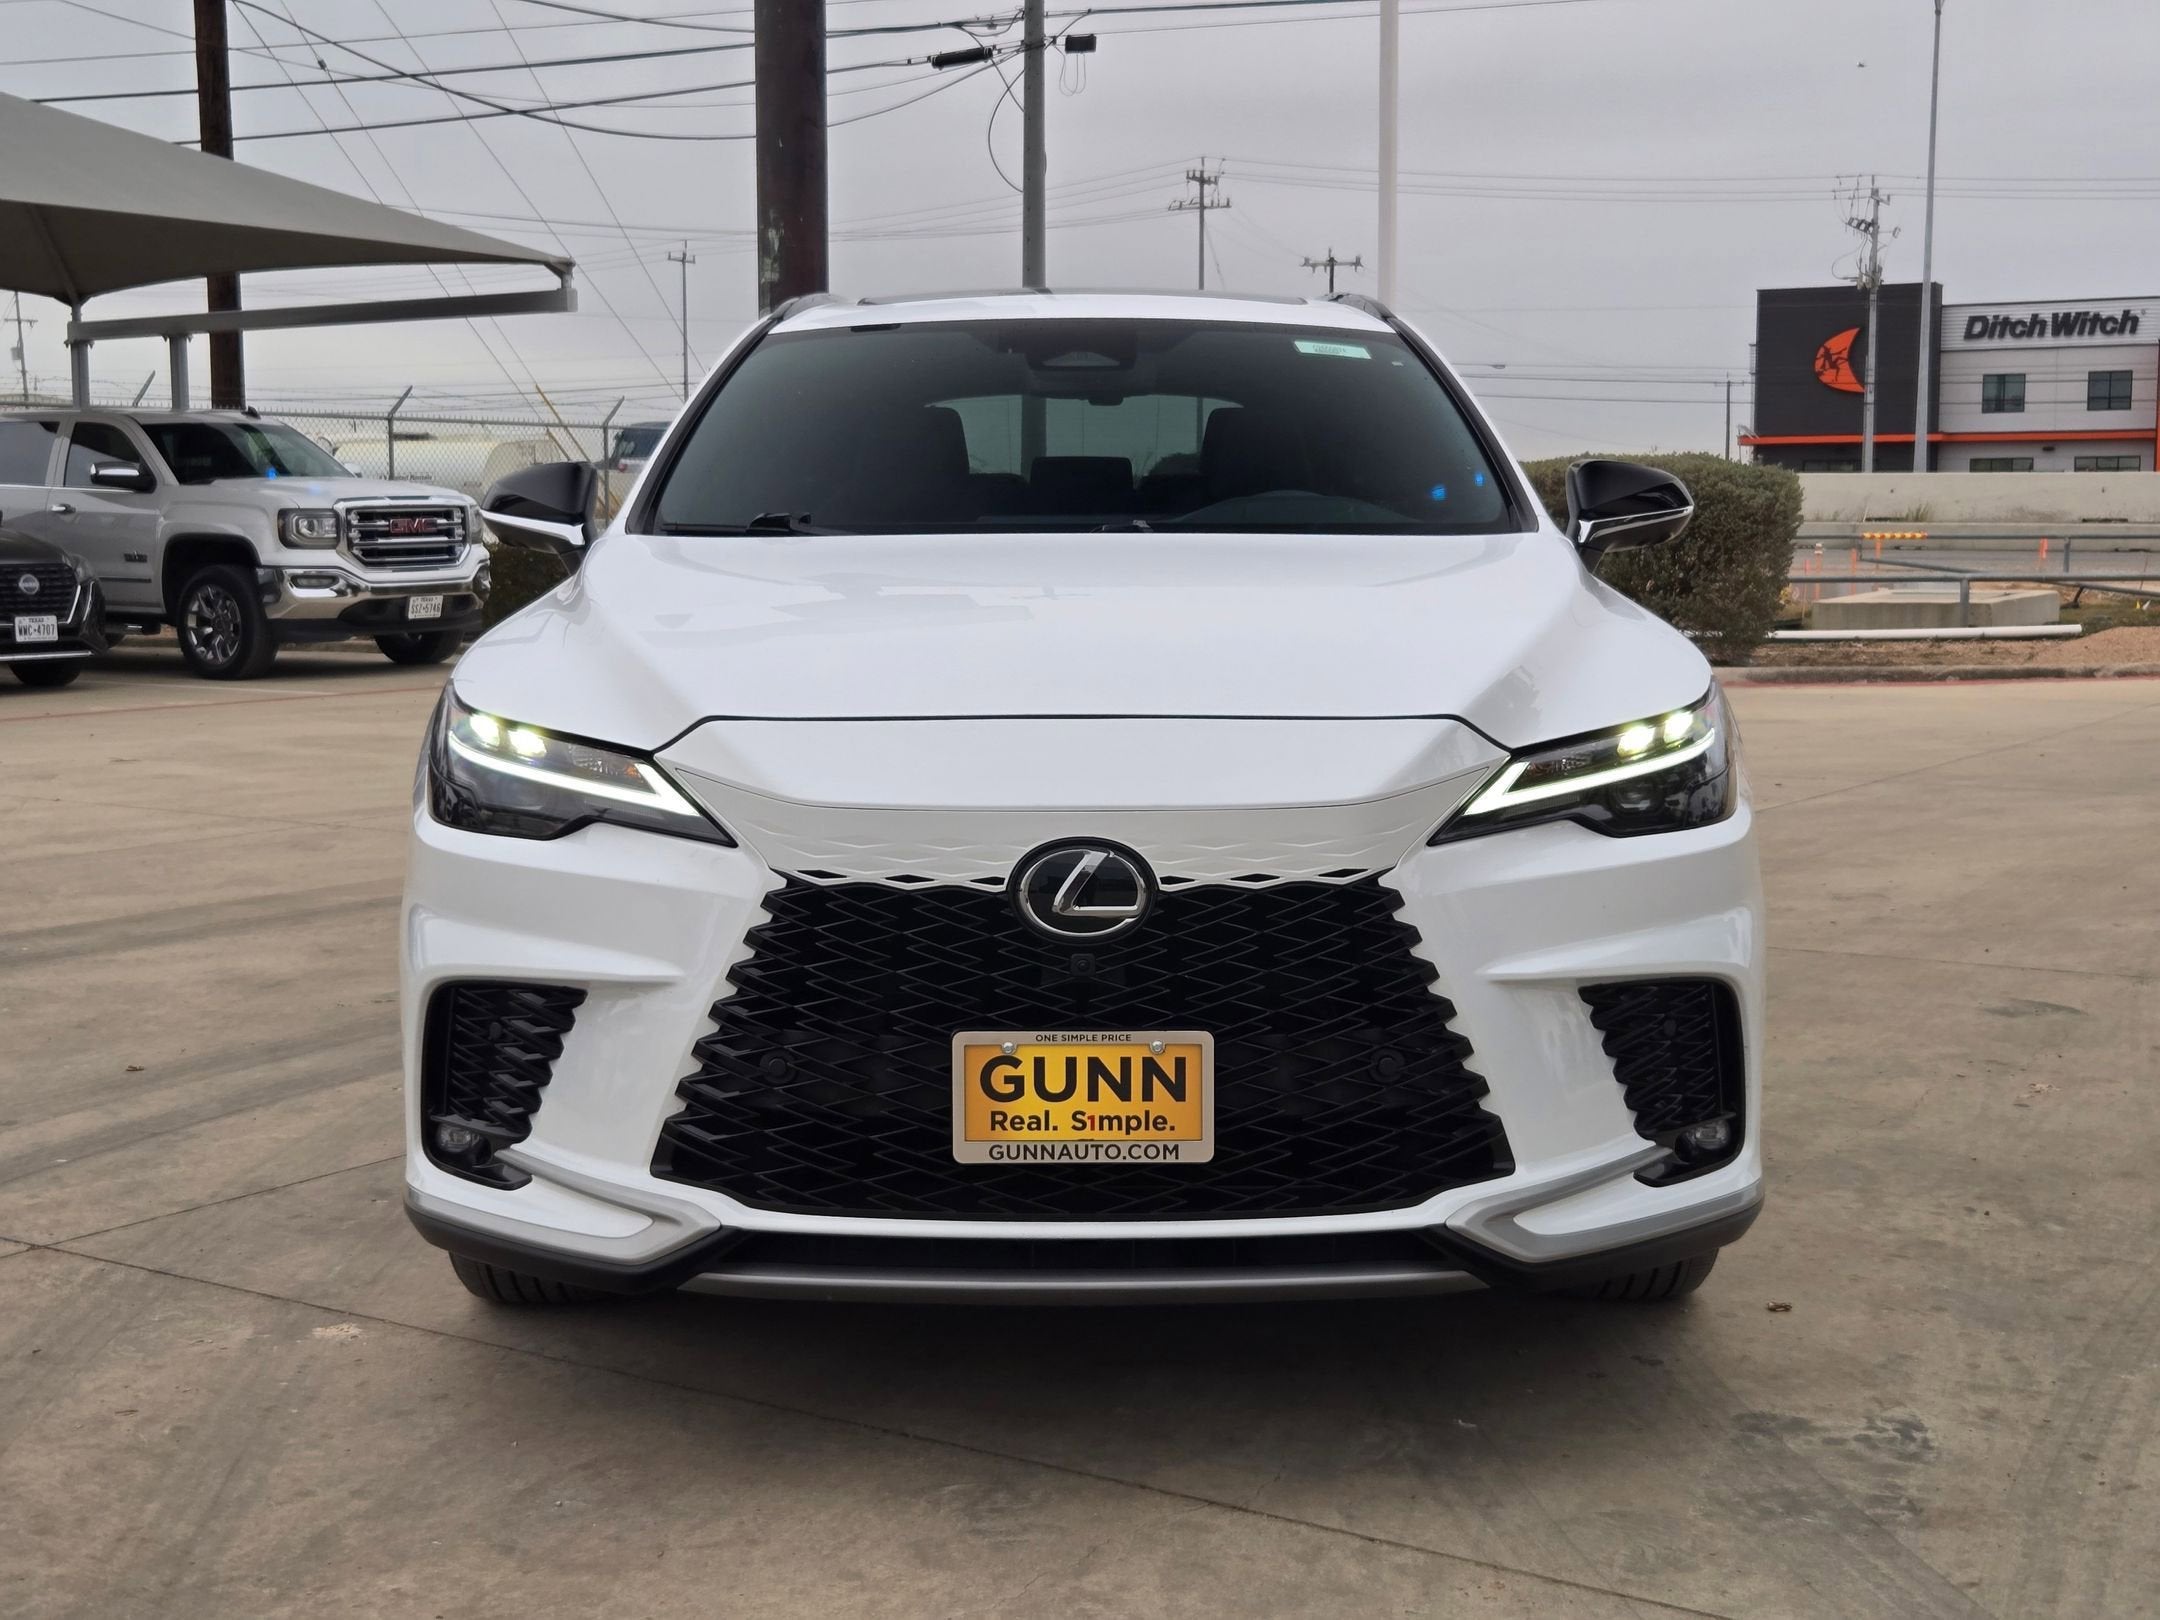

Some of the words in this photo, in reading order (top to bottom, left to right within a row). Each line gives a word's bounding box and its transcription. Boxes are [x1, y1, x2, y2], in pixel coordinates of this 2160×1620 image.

[1964, 314, 2047, 340] Ditch
[2051, 309, 2140, 337] Witch
[390, 518, 437, 533] GMC
[1035, 1034, 1058, 1042] ONE
[1061, 1034, 1098, 1042] SIMPLE
[1101, 1034, 1132, 1042] PRICE
[980, 1055, 1187, 1103] GUNN
[990, 1110, 1059, 1131] Real.
[988, 1143, 1180, 1161] GUNNAUTO.COM
